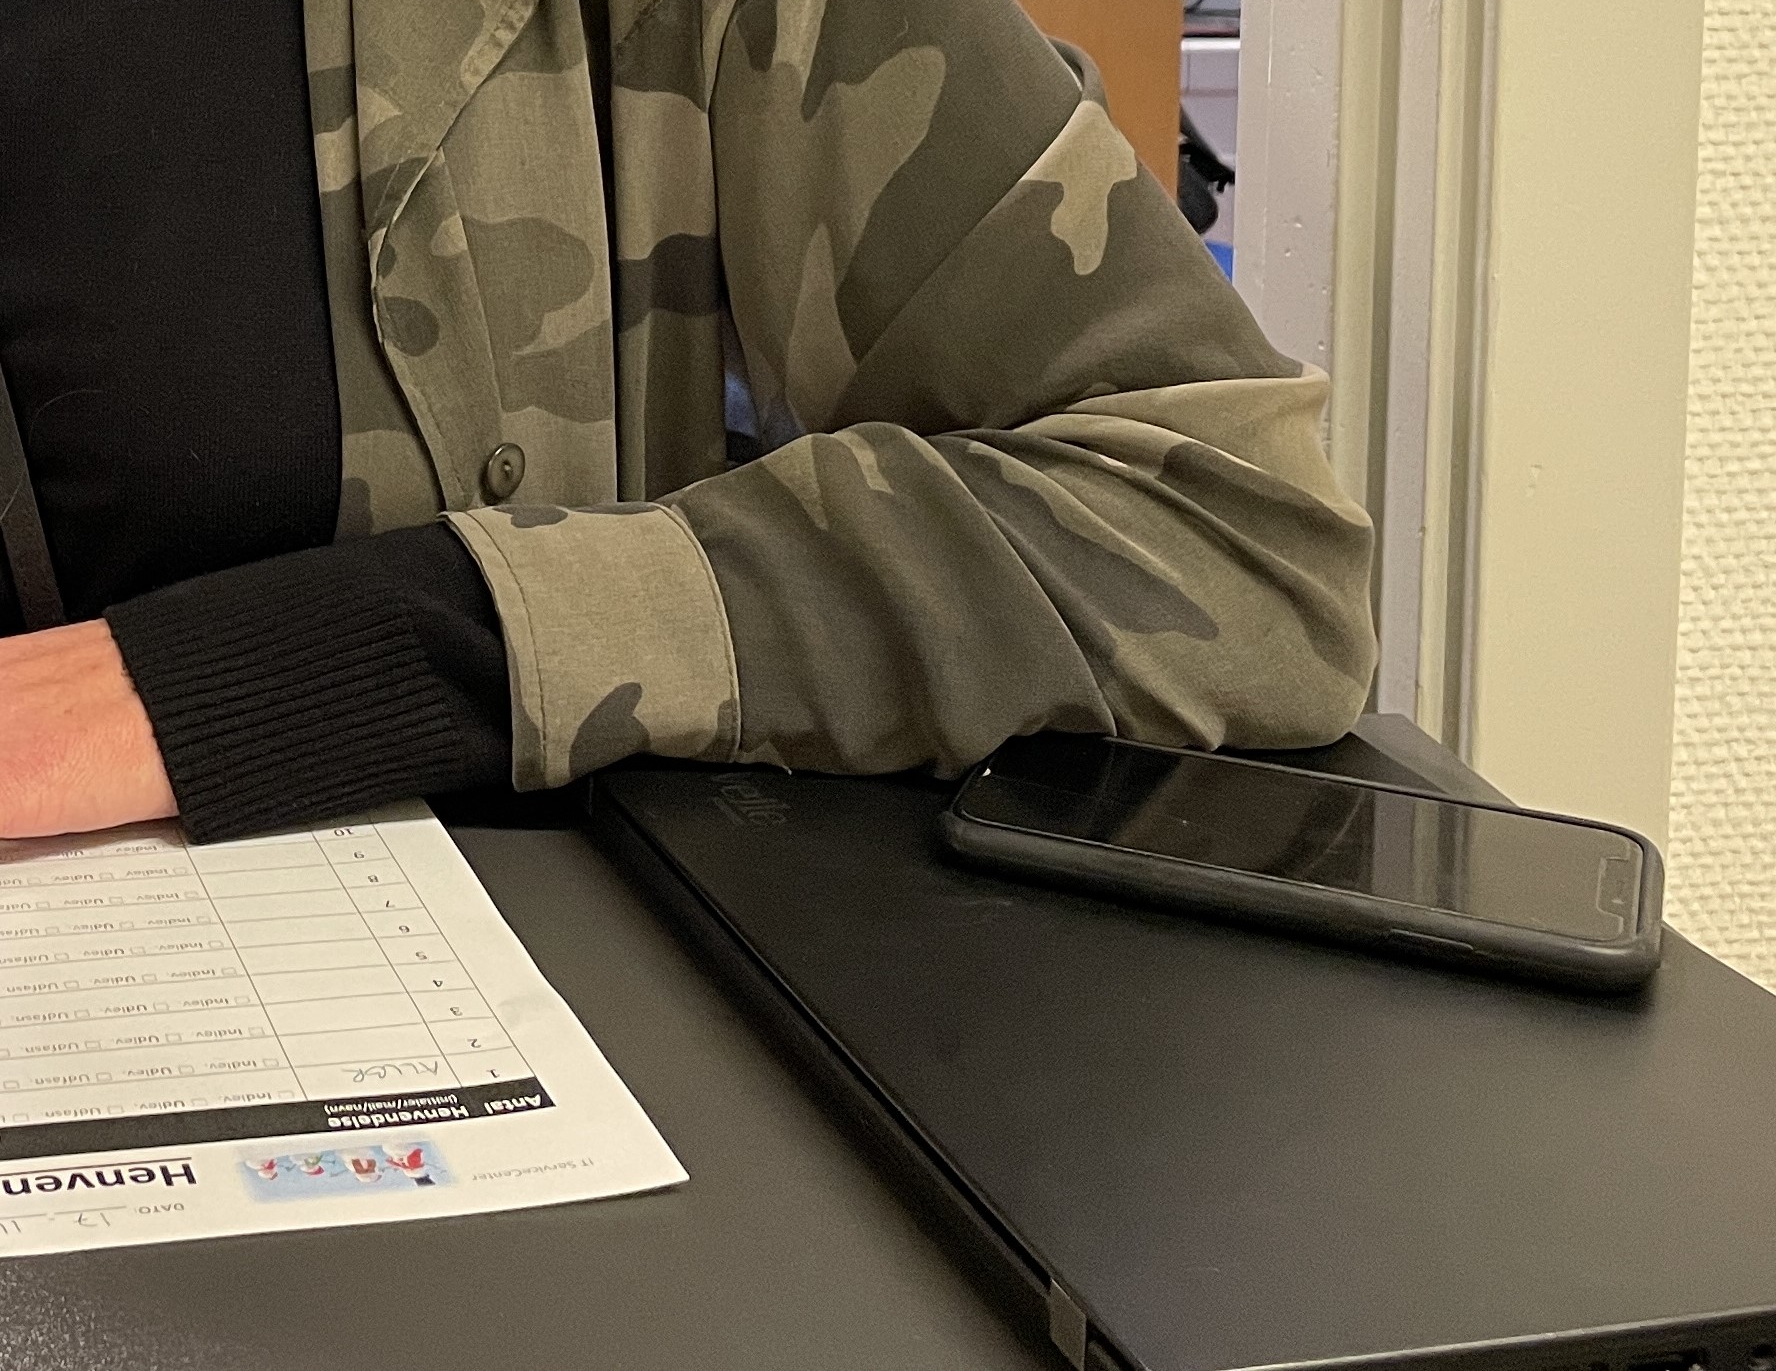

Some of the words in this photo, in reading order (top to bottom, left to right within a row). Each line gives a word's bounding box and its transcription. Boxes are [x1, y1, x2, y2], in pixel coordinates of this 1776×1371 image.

[334, 828, 354, 837] 10
[353, 851, 365, 859] 9
[385, 900, 395, 908] 7
[399, 925, 410, 933] 6
[416, 951, 427, 960] 5
[432, 979, 443, 988] 4
[450, 1006, 462, 1016] 3
[467, 1038, 481, 1048] 2
[489, 1069, 499, 1078] 1
[484, 1094, 541, 1113] Antal
[328, 1105, 468, 1128] Henvendelse
